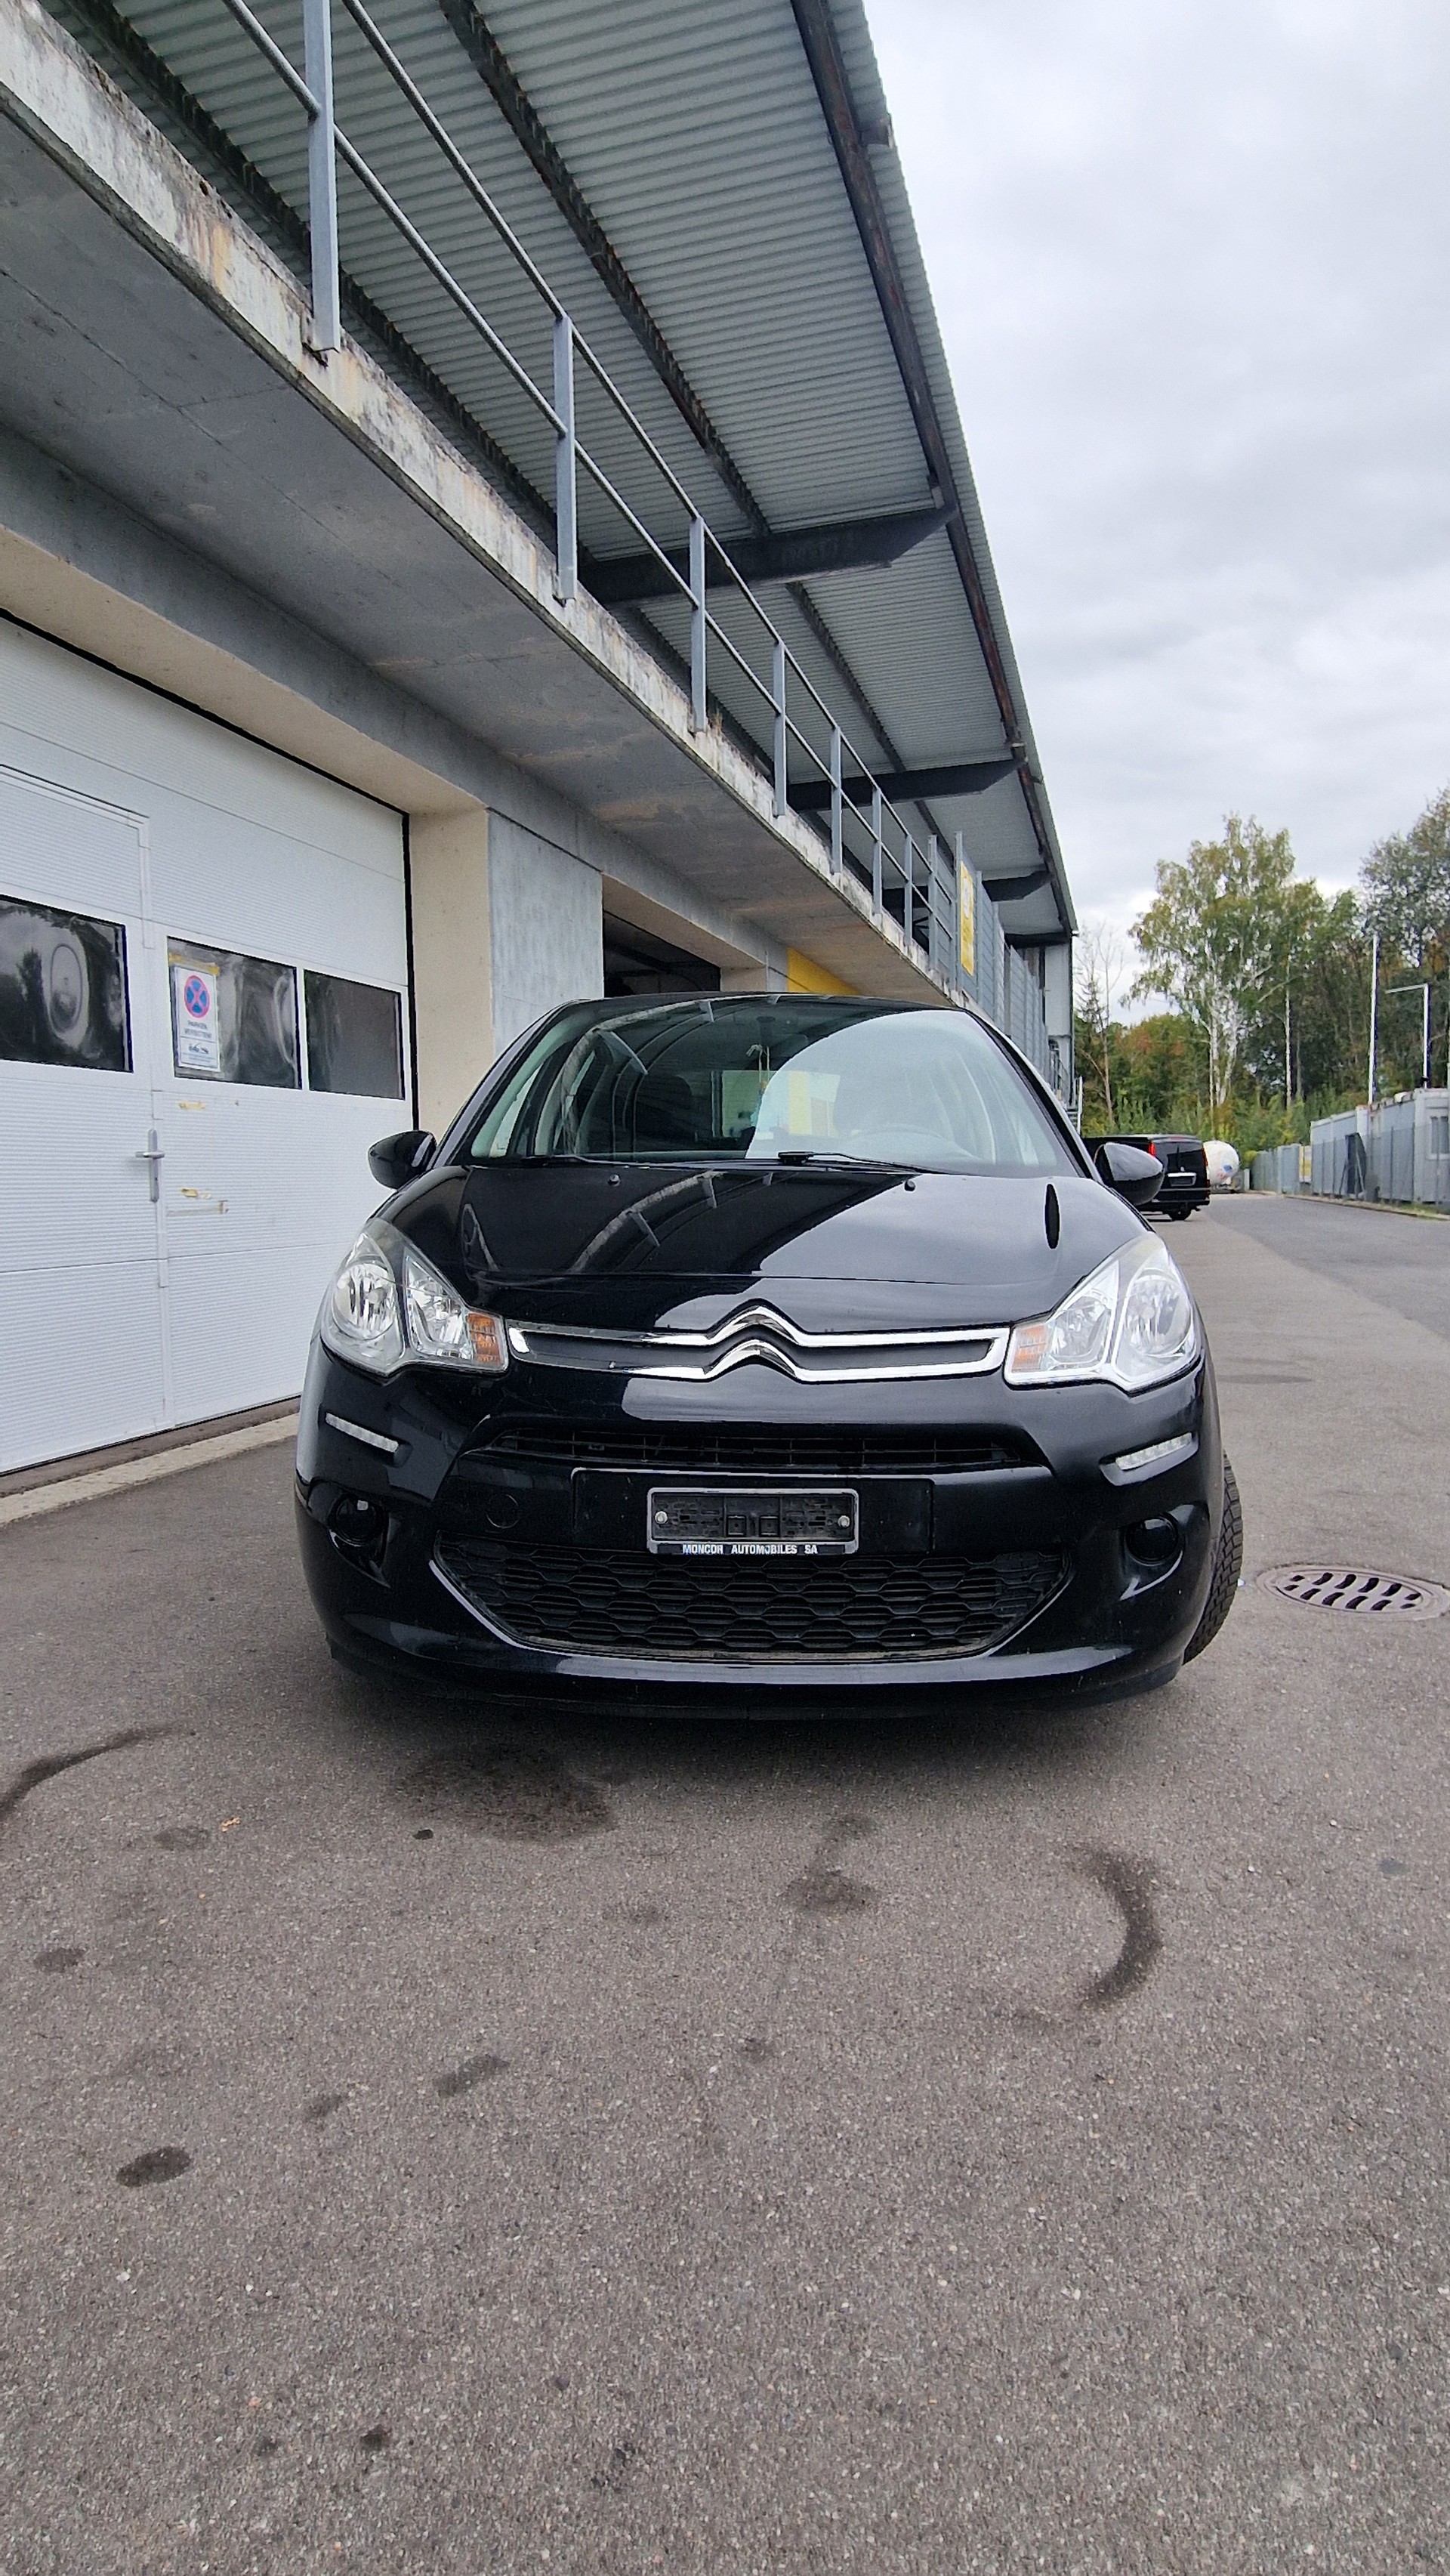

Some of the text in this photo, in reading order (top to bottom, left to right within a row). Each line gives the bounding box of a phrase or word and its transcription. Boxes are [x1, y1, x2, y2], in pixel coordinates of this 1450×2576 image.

[682, 1543, 819, 1555] MONCOR AUTOMOBILES SA
